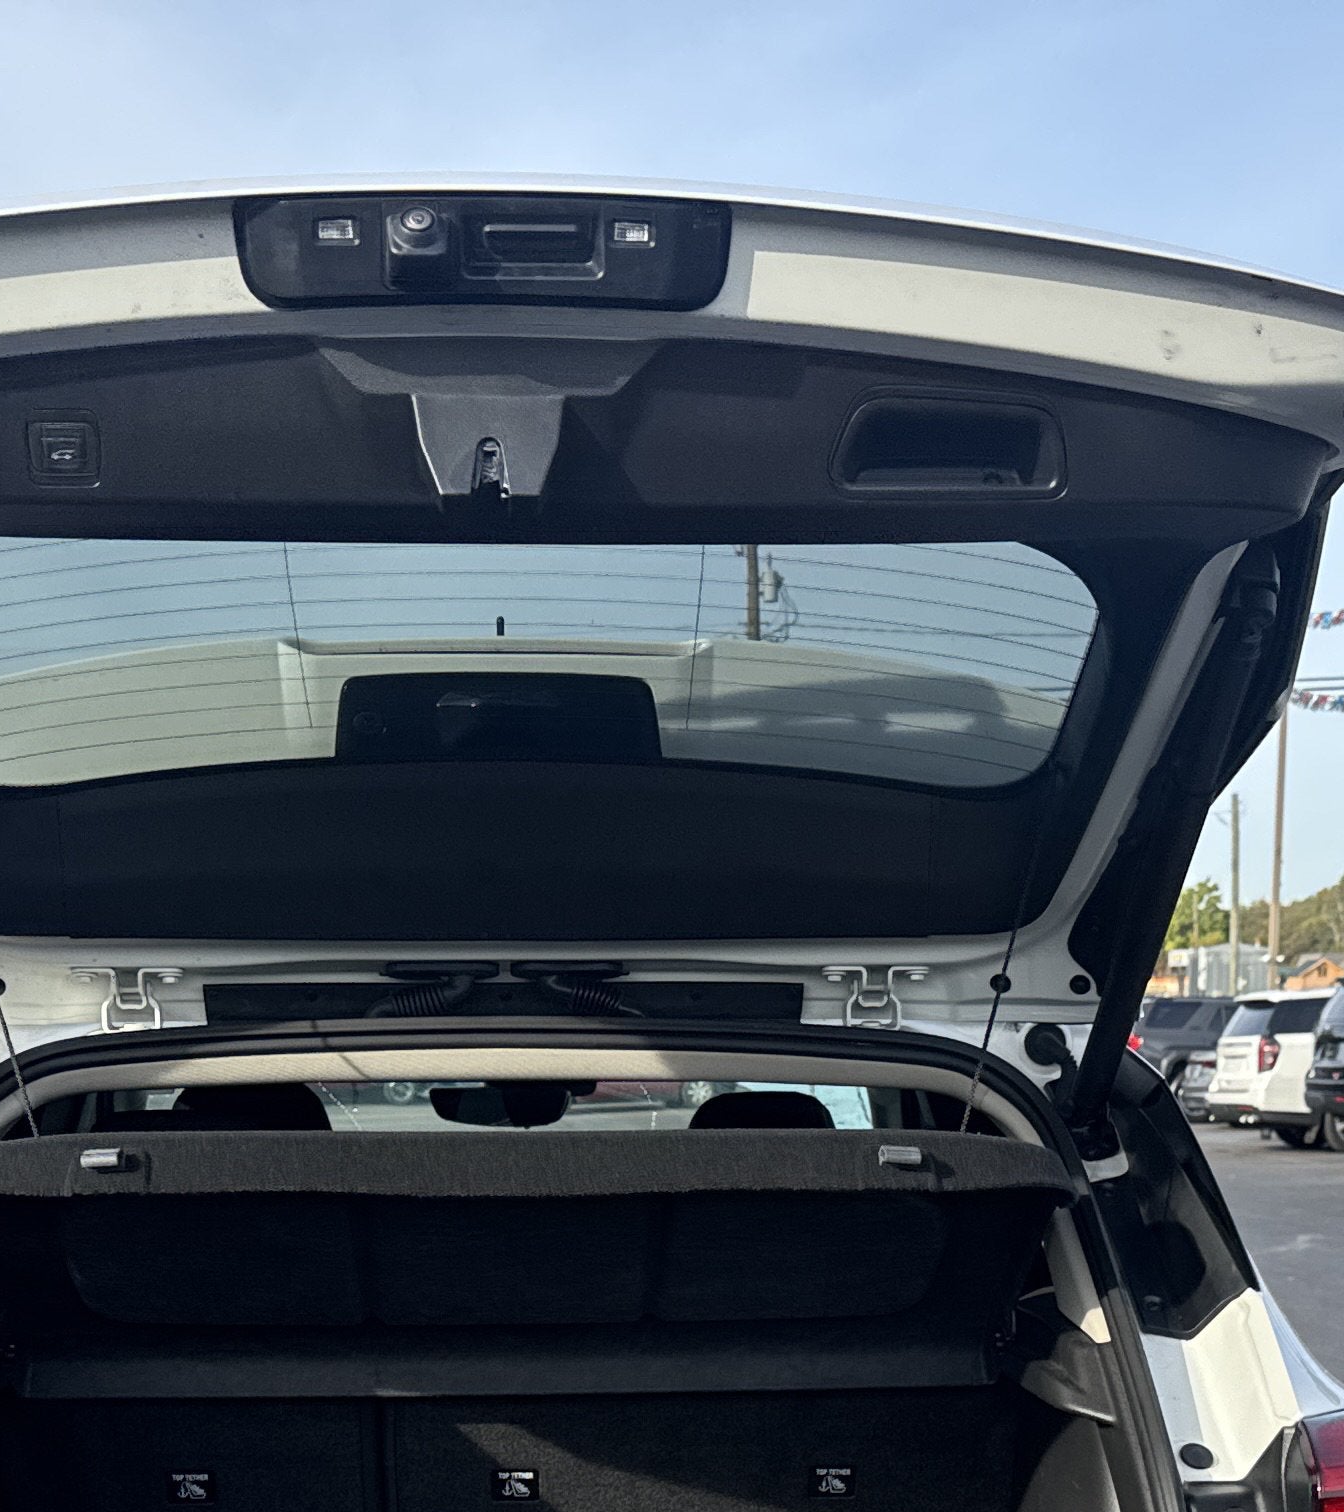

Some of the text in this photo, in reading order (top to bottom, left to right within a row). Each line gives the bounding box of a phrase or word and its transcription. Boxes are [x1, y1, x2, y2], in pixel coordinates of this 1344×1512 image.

[185, 1473, 208, 1481] TETHER
[498, 1471, 534, 1479] TOP TETHER
